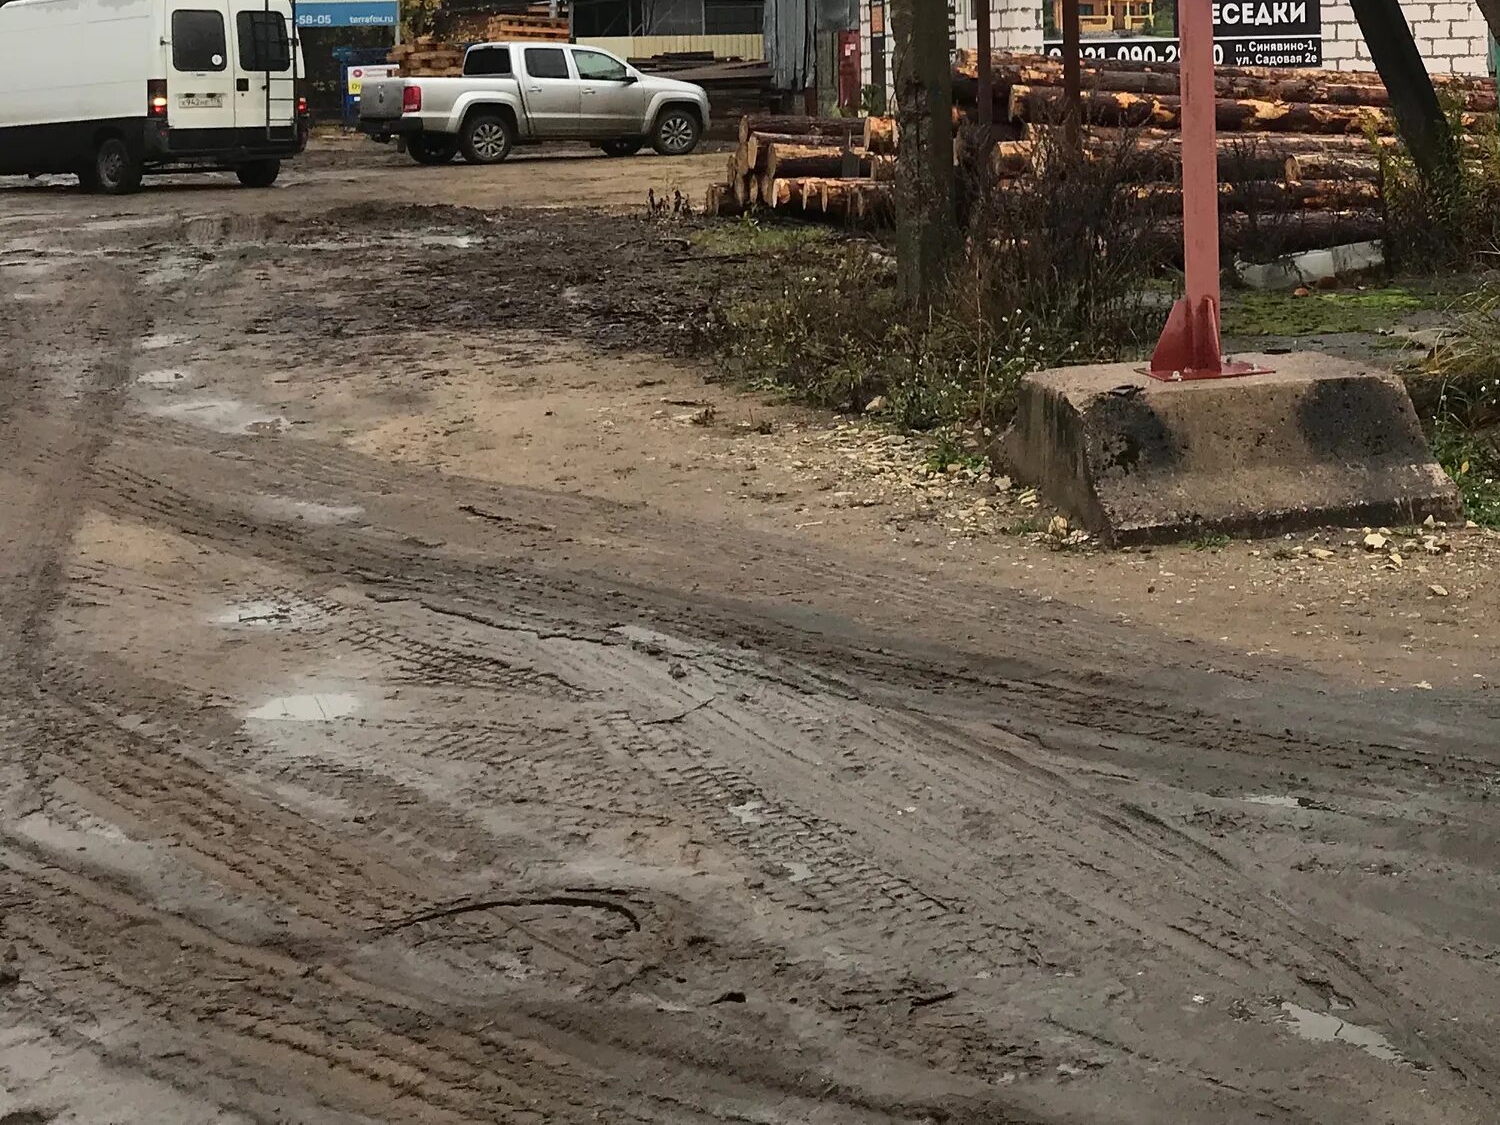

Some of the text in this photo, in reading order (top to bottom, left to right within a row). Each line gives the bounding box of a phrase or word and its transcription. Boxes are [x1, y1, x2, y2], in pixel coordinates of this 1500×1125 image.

[1212, 2, 1306, 26] ЕСЕДКИ
[1235, 56, 1253, 66] ул.
[1255, 54, 1303, 65] Садовая
